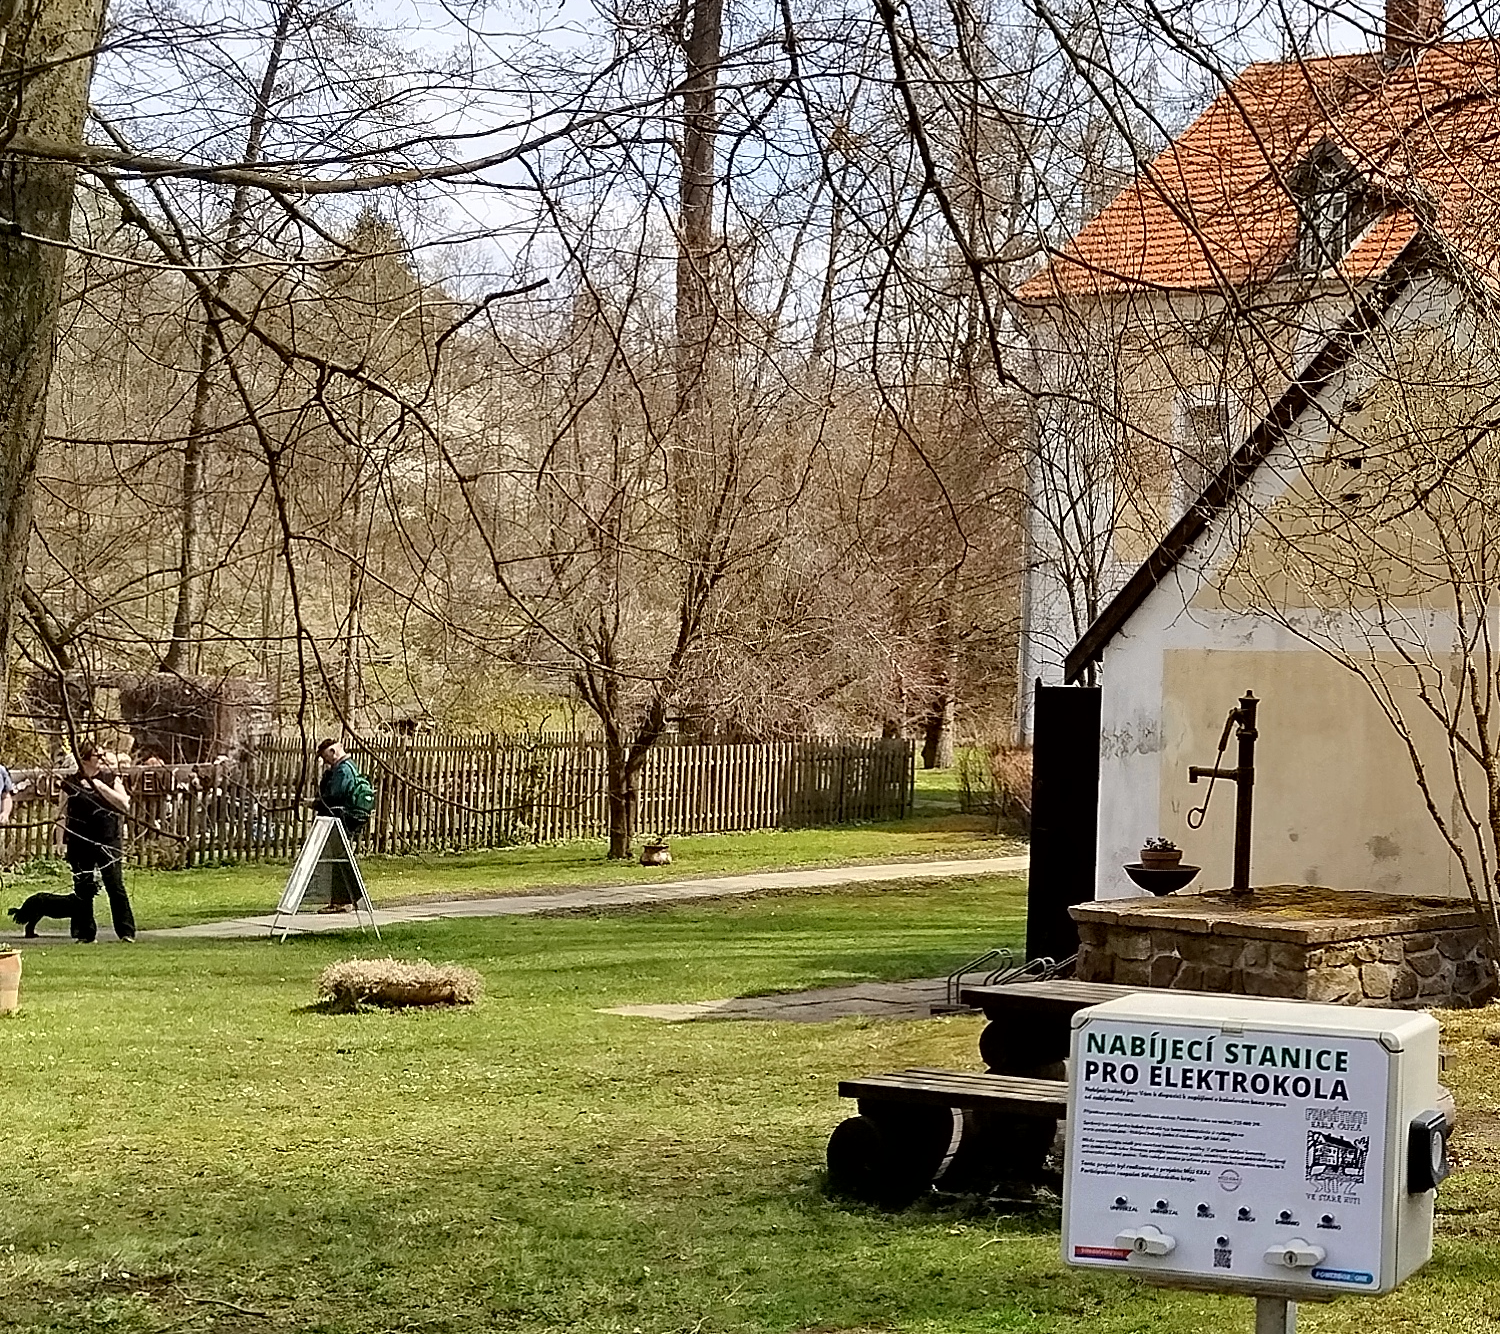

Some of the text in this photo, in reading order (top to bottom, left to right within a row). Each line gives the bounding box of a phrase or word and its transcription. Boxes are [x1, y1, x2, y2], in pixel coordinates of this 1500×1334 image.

[1086, 1031, 1348, 1072] NABÍJECÍ STANICE
[1084, 1060, 1139, 1085] PRO
[1149, 1065, 1349, 1101] ELEKTROKOLA
